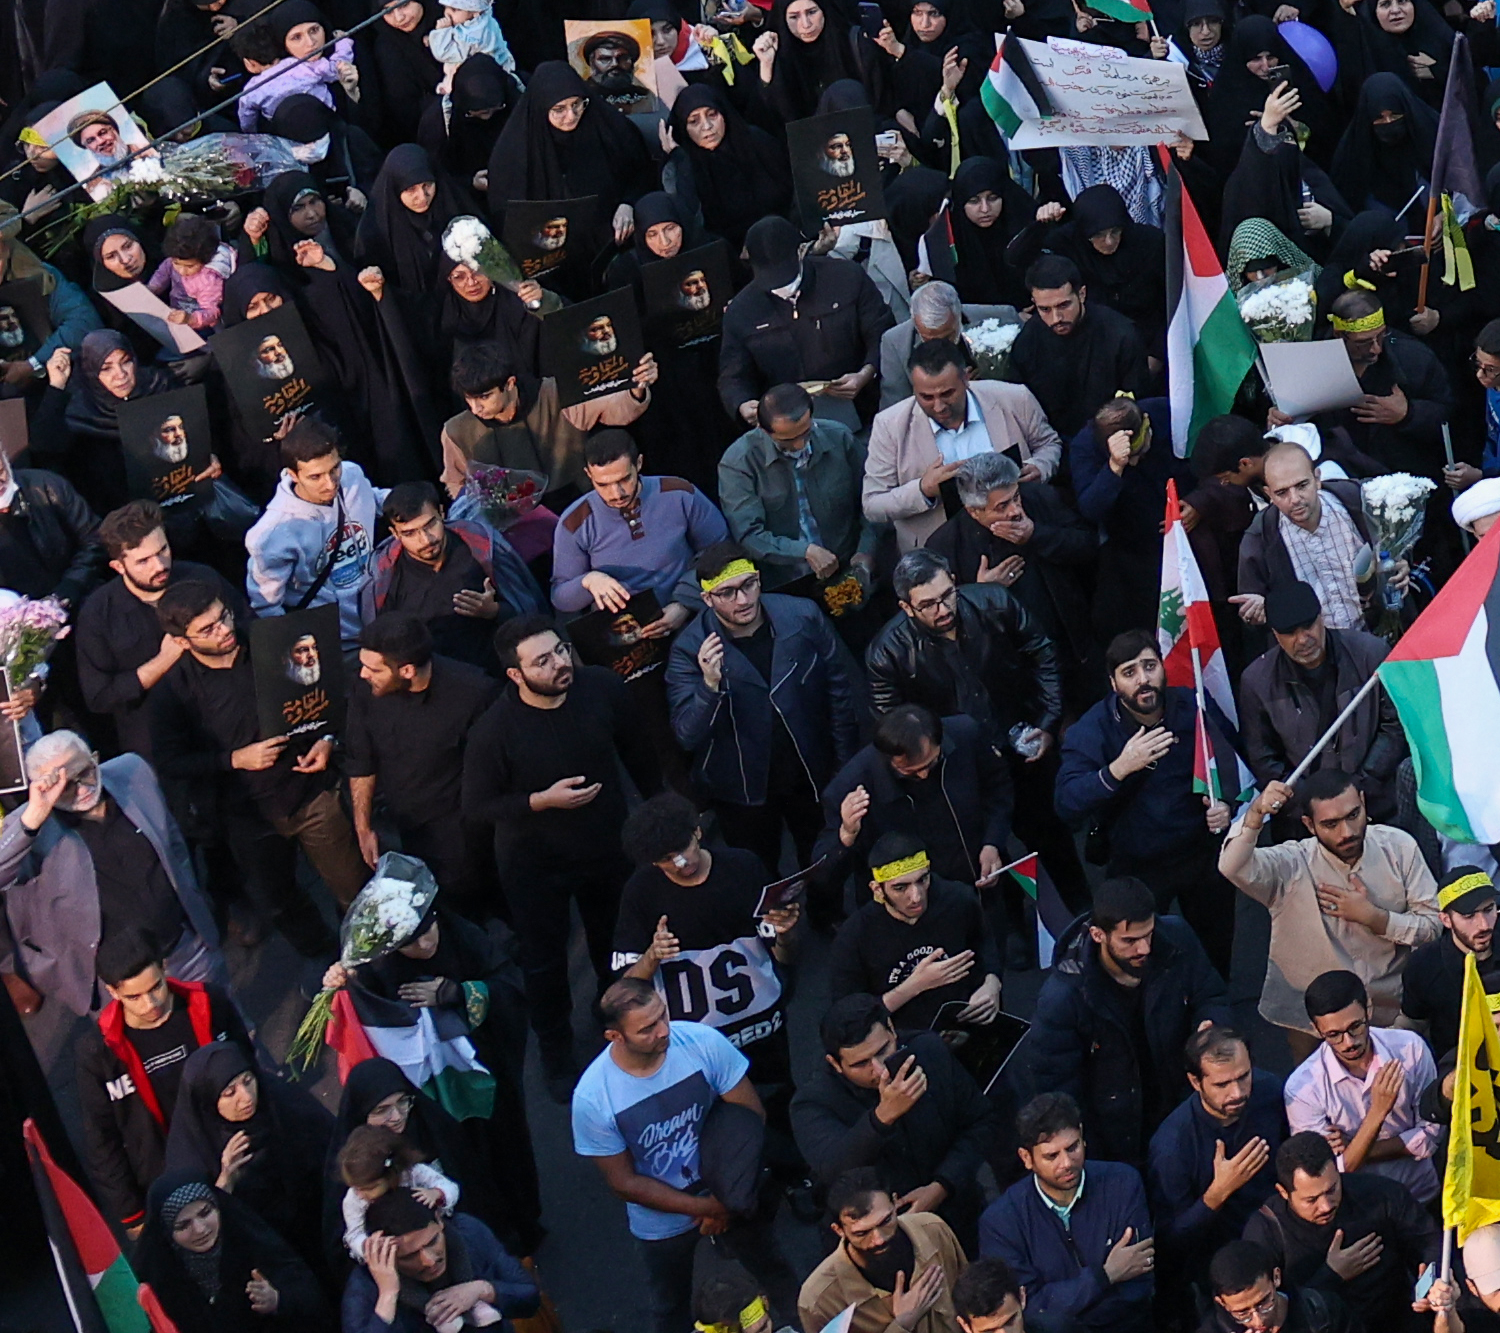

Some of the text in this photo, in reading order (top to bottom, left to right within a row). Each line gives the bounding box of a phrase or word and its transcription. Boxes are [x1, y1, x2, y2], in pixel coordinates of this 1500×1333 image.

[907, 945, 934, 961] GOOD
[661, 949, 756, 1022] DS
[638, 1101, 705, 1149] Dream
[644, 1124, 700, 1176] Big
